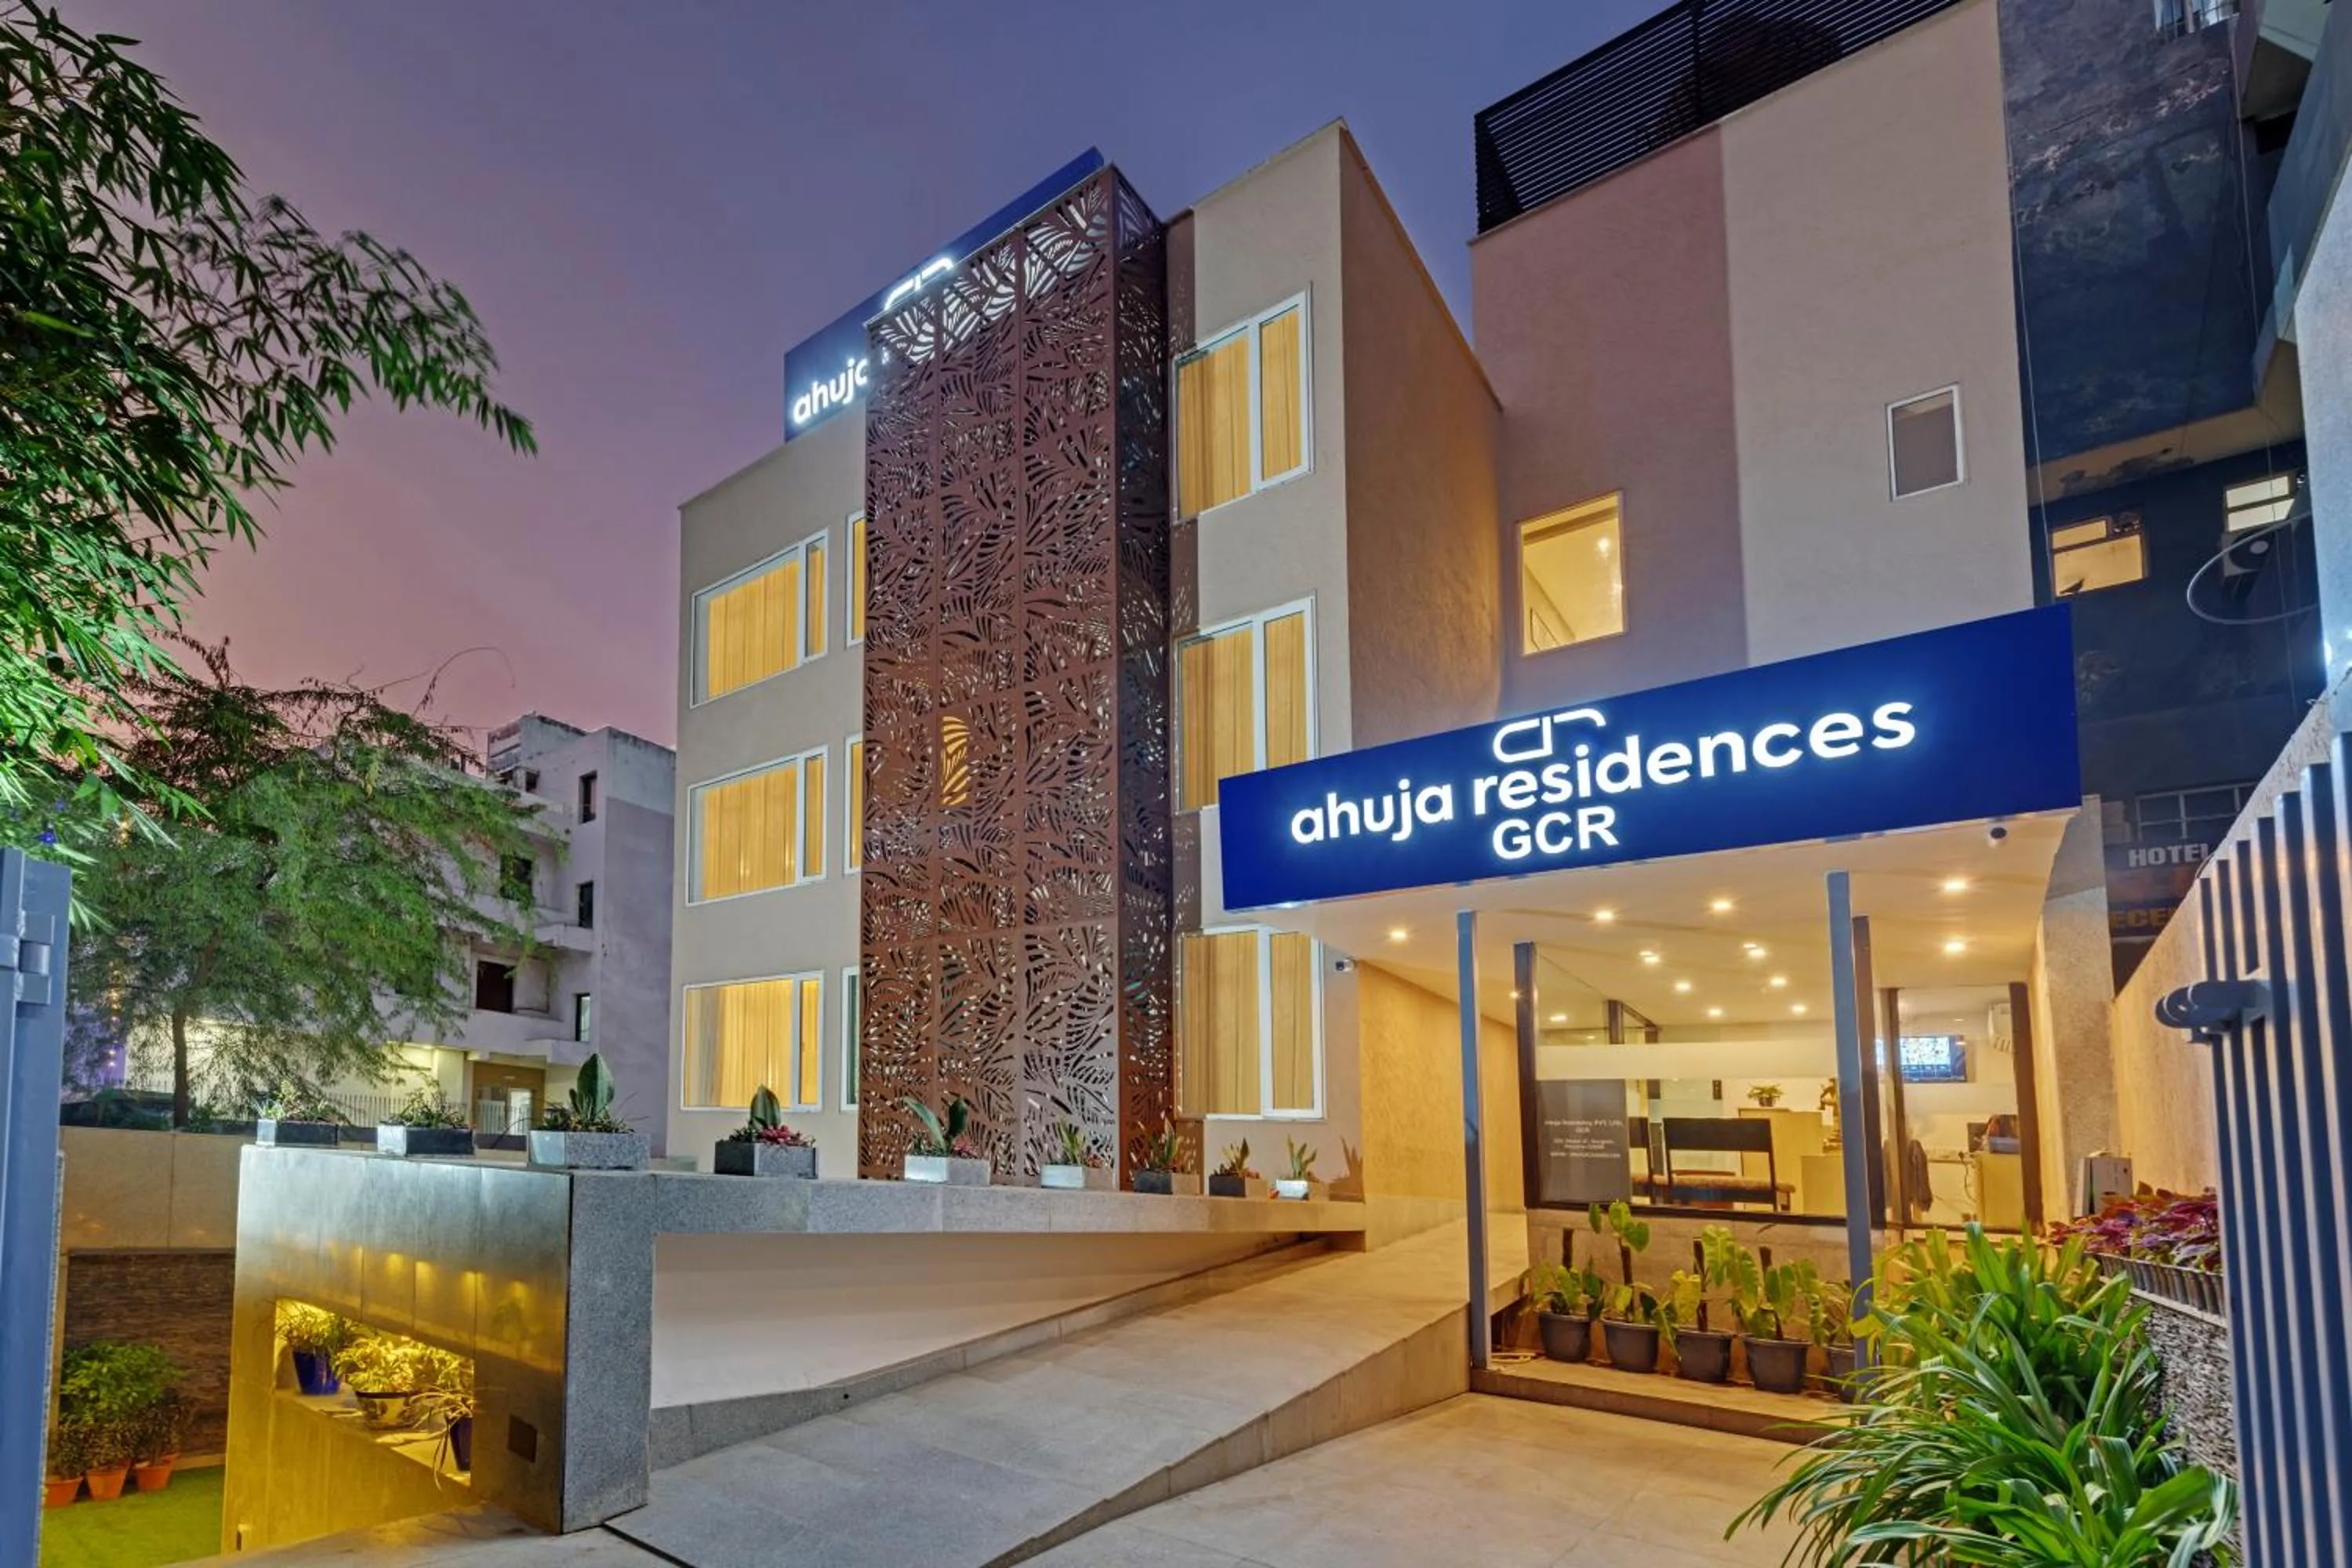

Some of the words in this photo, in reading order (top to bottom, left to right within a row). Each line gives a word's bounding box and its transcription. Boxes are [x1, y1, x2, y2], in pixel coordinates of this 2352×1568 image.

[1291, 776, 1454, 844] ahuja
[1474, 702, 1916, 816] residences
[1492, 805, 1620, 860] GCR
